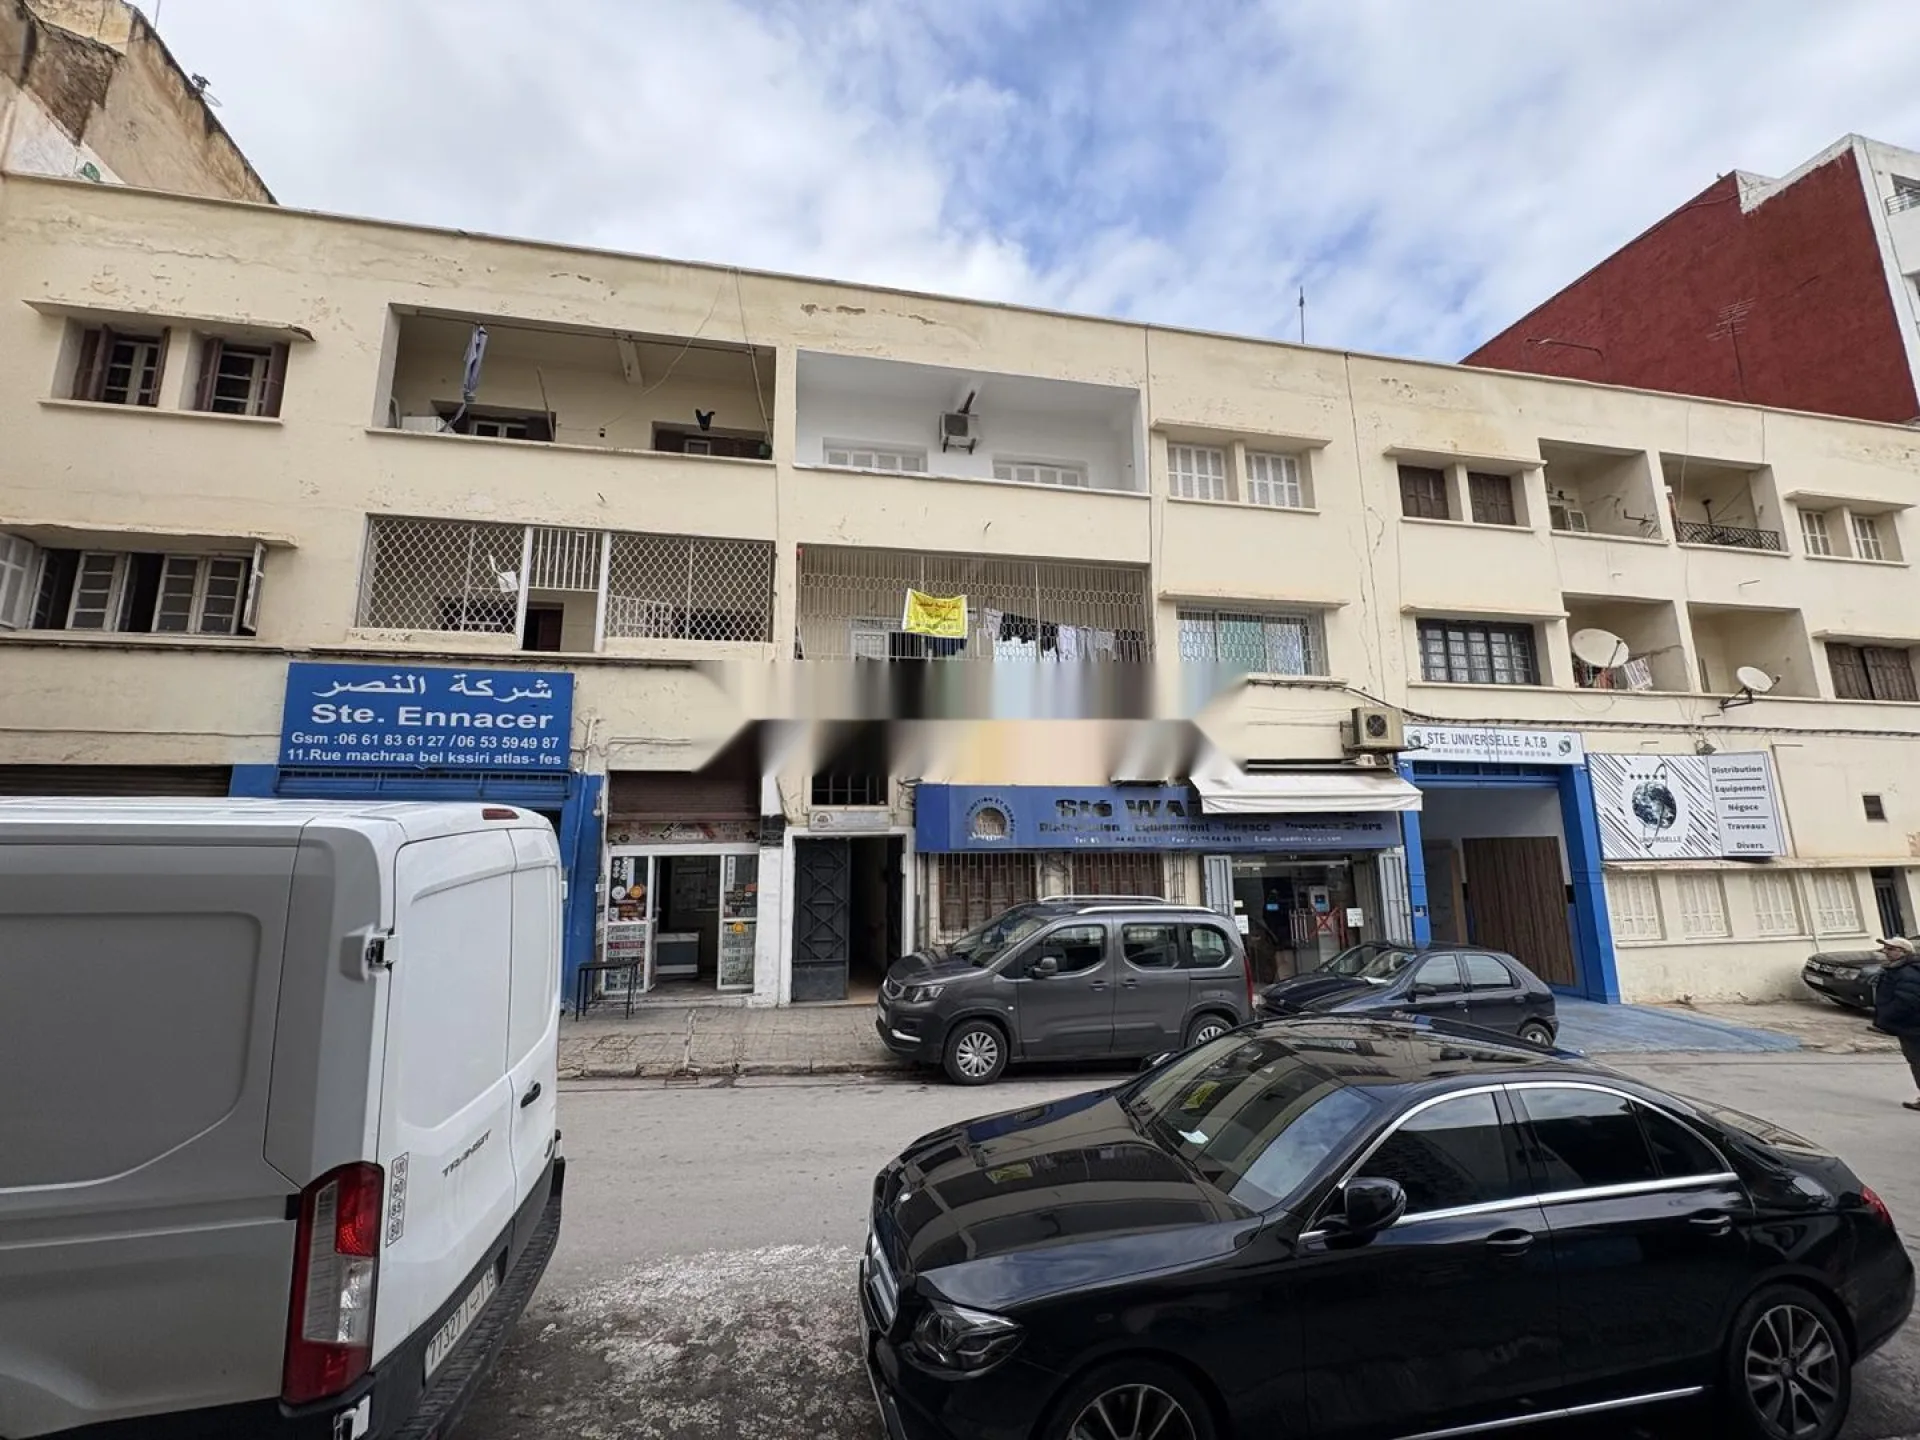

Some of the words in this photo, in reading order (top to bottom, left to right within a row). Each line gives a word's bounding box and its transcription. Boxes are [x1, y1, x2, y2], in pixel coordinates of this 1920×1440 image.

[312, 674, 426, 697] النصر
[449, 673, 552, 703] شركة
[311, 703, 385, 724] Ste.
[397, 705, 554, 729] Ennacer
[292, 732, 328, 745] Gsm
[362, 734, 378, 745] 61
[384, 734, 402, 746] 83
[480, 736, 497, 748] 53
[542, 737, 559, 749] 87
[1451, 733, 1520, 747] UNIVERSELLE
[346, 750, 414, 762] machraa
[420, 752, 443, 763] bel
[448, 752, 489, 764] kssiri
[1711, 765, 1763, 774] Distribution
[1715, 784, 1766, 793] Equipement
[1736, 841, 1764, 849] Divers
